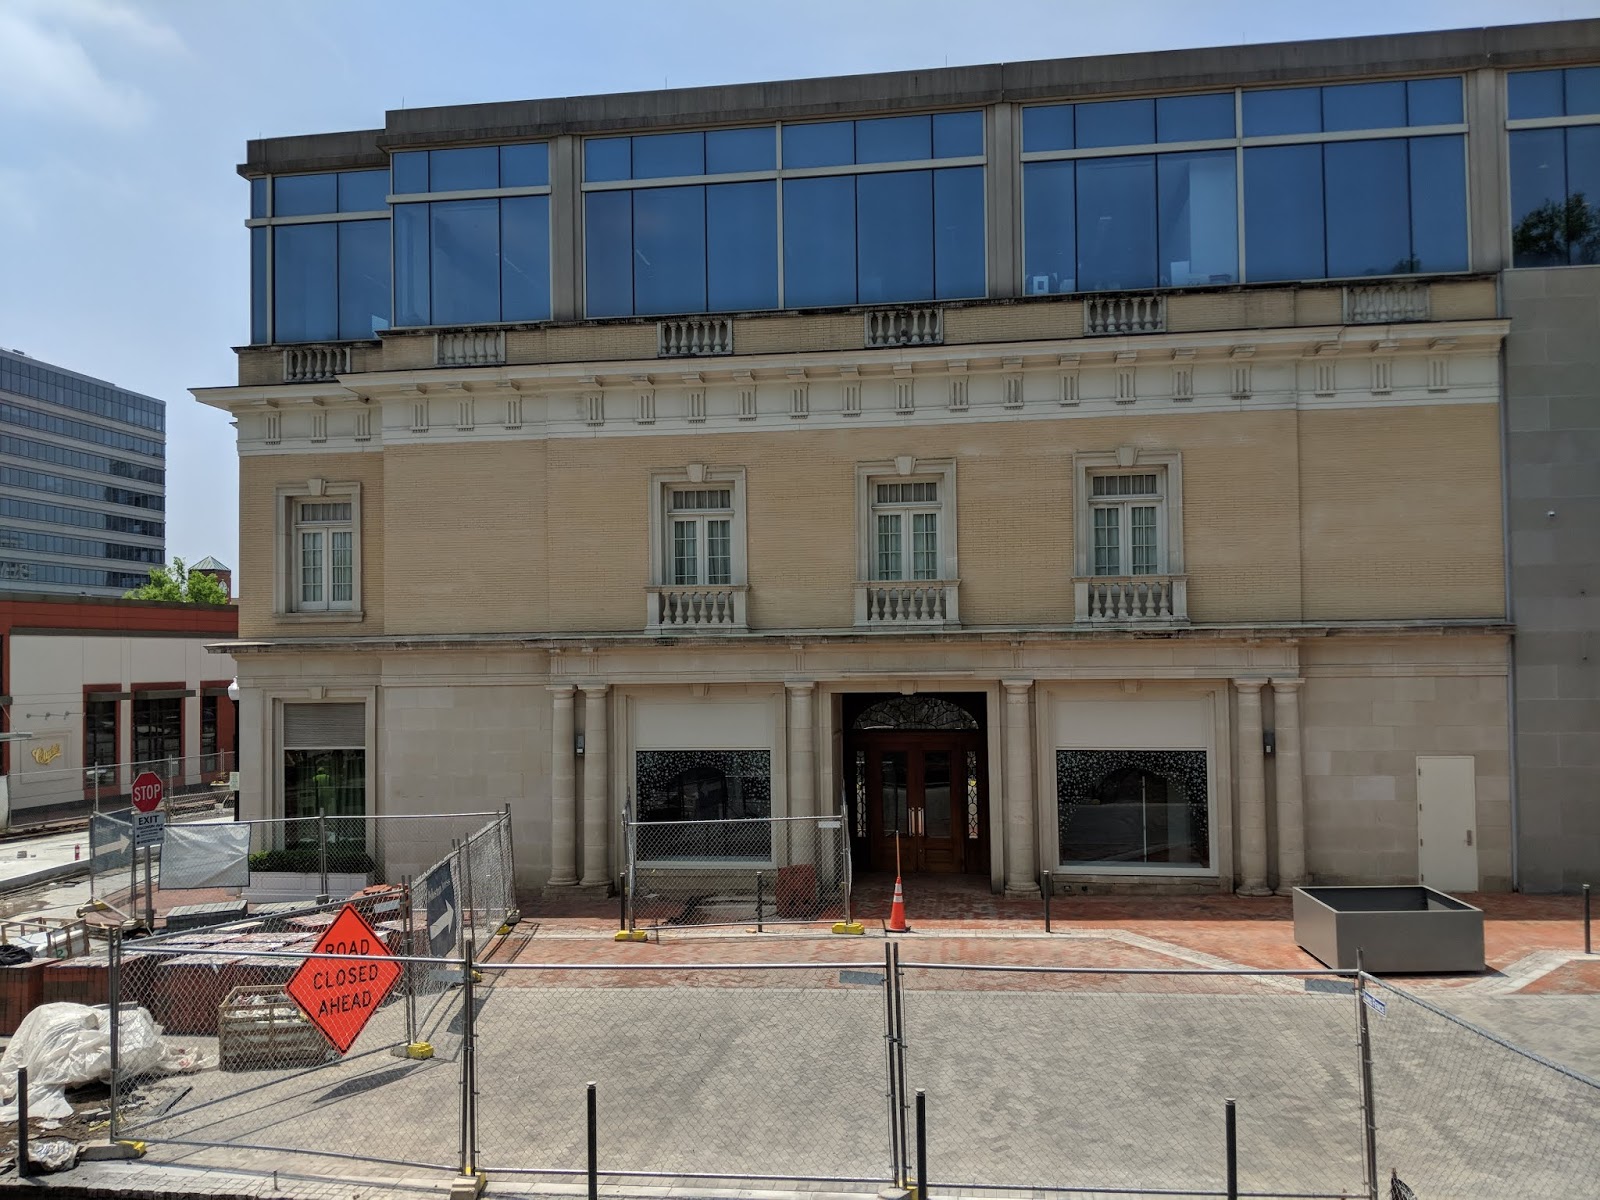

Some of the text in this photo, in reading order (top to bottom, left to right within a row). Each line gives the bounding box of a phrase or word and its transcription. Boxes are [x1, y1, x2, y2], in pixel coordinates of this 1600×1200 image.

[134, 783, 161, 802] STOP
[138, 815, 160, 826] EXIT
[325, 939, 370, 959] ROAD
[313, 964, 378, 990] CLOSED
[317, 991, 372, 1018] AHEAD
